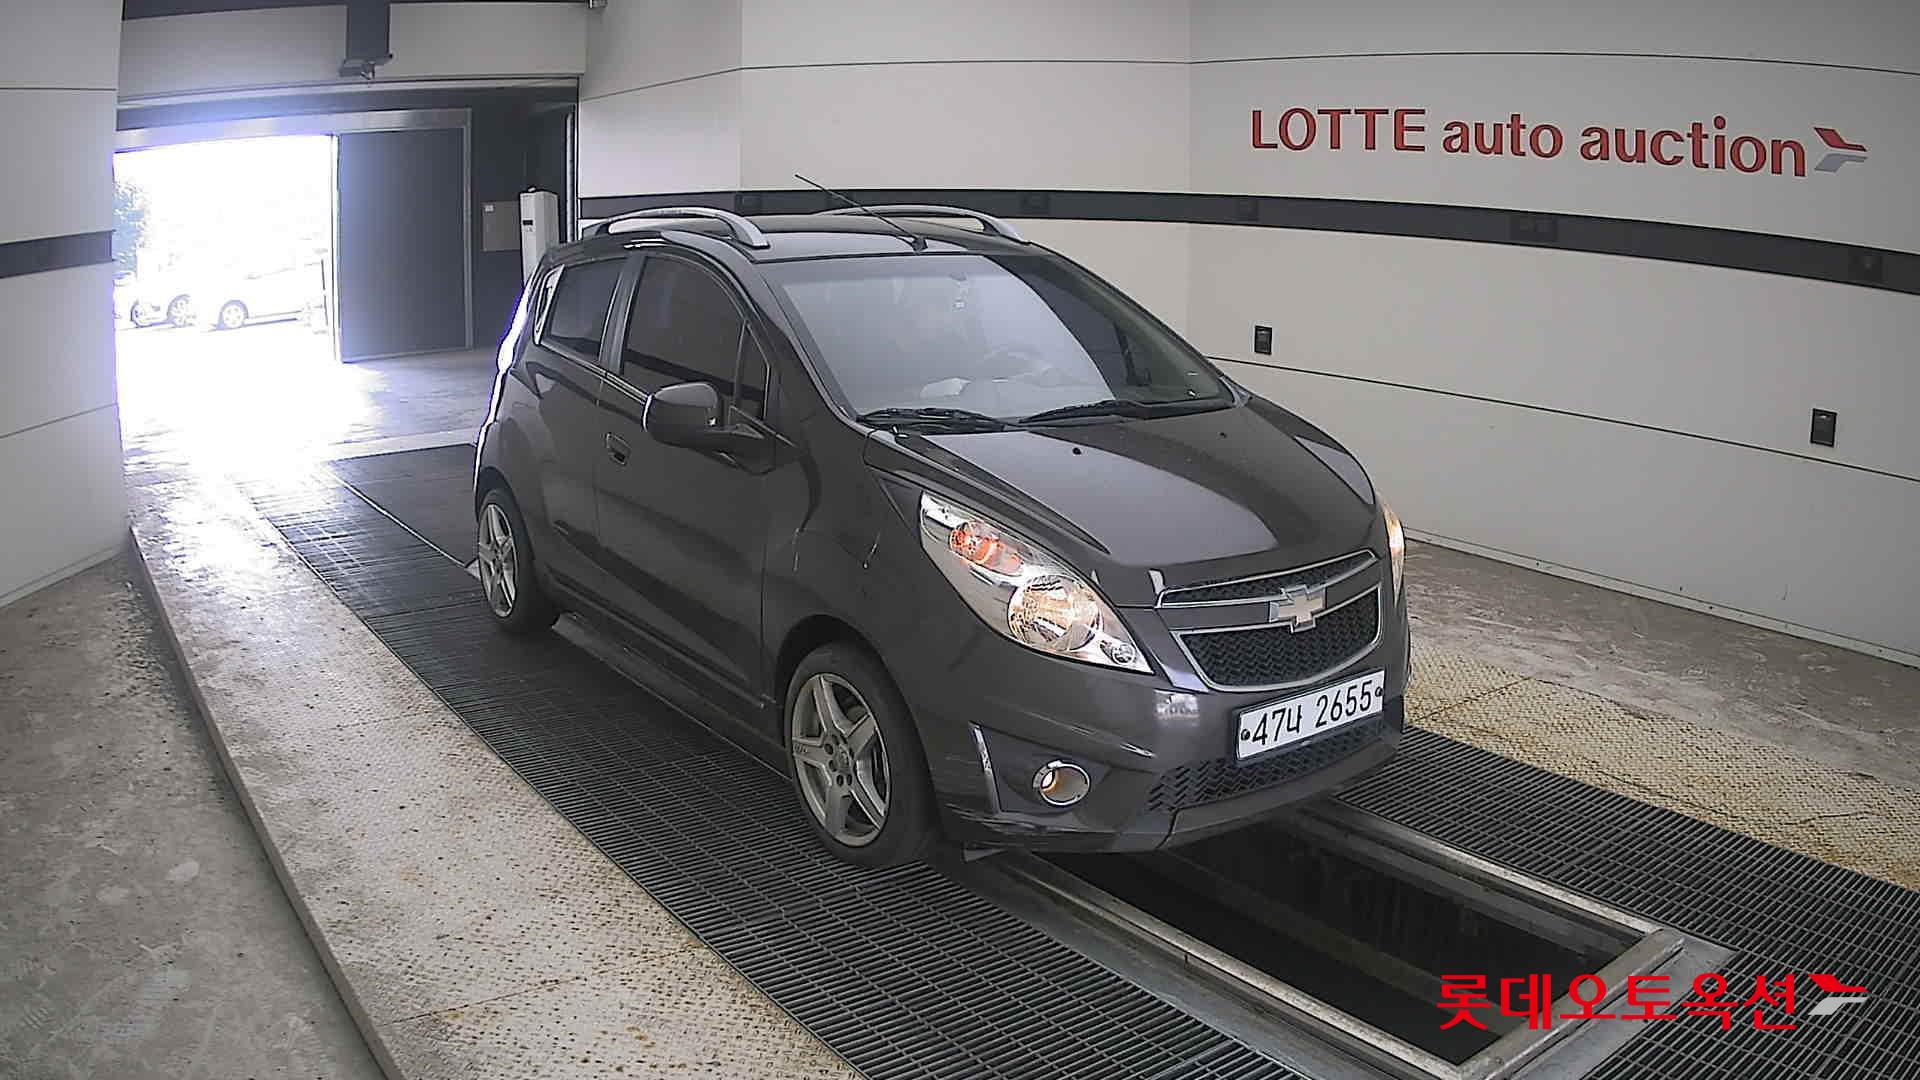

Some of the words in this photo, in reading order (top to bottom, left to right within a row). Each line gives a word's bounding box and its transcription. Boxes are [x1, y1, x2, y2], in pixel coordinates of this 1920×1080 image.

[1252, 108, 1426, 151] LOTTE
[1442, 113, 1564, 158] auto
[1579, 115, 1807, 178] auction
[1252, 704, 1302, 745] 47나
[1315, 680, 1373, 728] 2655
